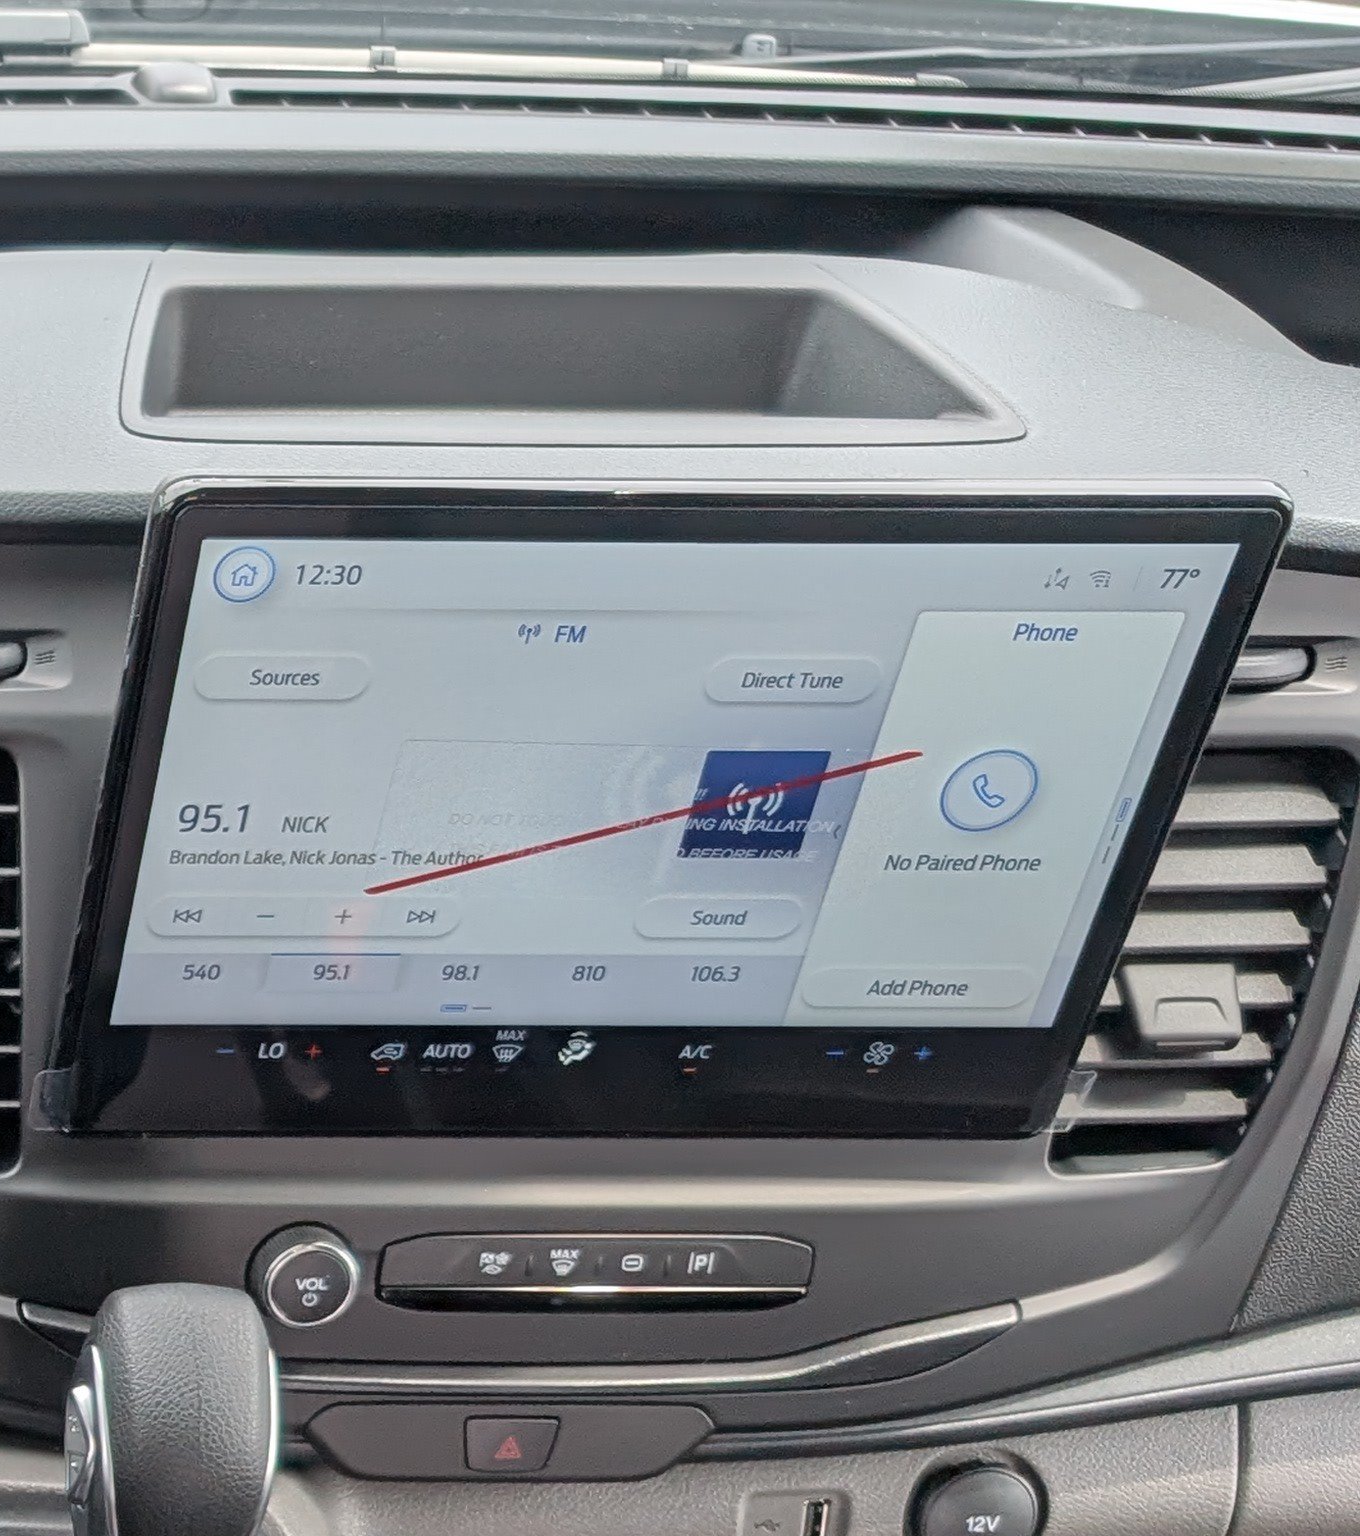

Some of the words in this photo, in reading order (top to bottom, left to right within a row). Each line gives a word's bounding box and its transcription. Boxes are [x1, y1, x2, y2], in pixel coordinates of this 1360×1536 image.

[294, 564, 363, 587] 12:30
[554, 625, 587, 644] FM
[1012, 623, 1079, 644] Phone
[248, 668, 321, 688] Sources
[740, 671, 795, 690] Direct
[798, 671, 844, 690] Tune
[178, 804, 252, 834] 95.1
[281, 816, 330, 834] NICK
[169, 850, 240, 866] Brandon
[244, 850, 286, 867] Lake,
[290, 850, 325, 866] Nick
[328, 850, 376, 866] Jonas
[391, 850, 422, 866] The
[883, 855, 912, 871] No
[915, 854, 978, 871] Paired
[979, 854, 1041, 871] Phone
[690, 910, 748, 927] Sound
[182, 965, 221, 981] 540
[313, 965, 351, 981] 95.1
[441, 965, 480, 981] 98.1
[572, 965, 607, 982] 810
[691, 965, 741, 982] 106.3
[867, 980, 908, 996] Add
[908, 980, 969, 996] Phone
[496, 1030, 527, 1042] MAX
[258, 1042, 285, 1059] LO
[422, 1044, 472, 1059] AUTO
[679, 1044, 713, 1060] A/C
[550, 1249, 579, 1259] MAX
[294, 1277, 328, 1292] VOL
[966, 1515, 1001, 1533] 12V
